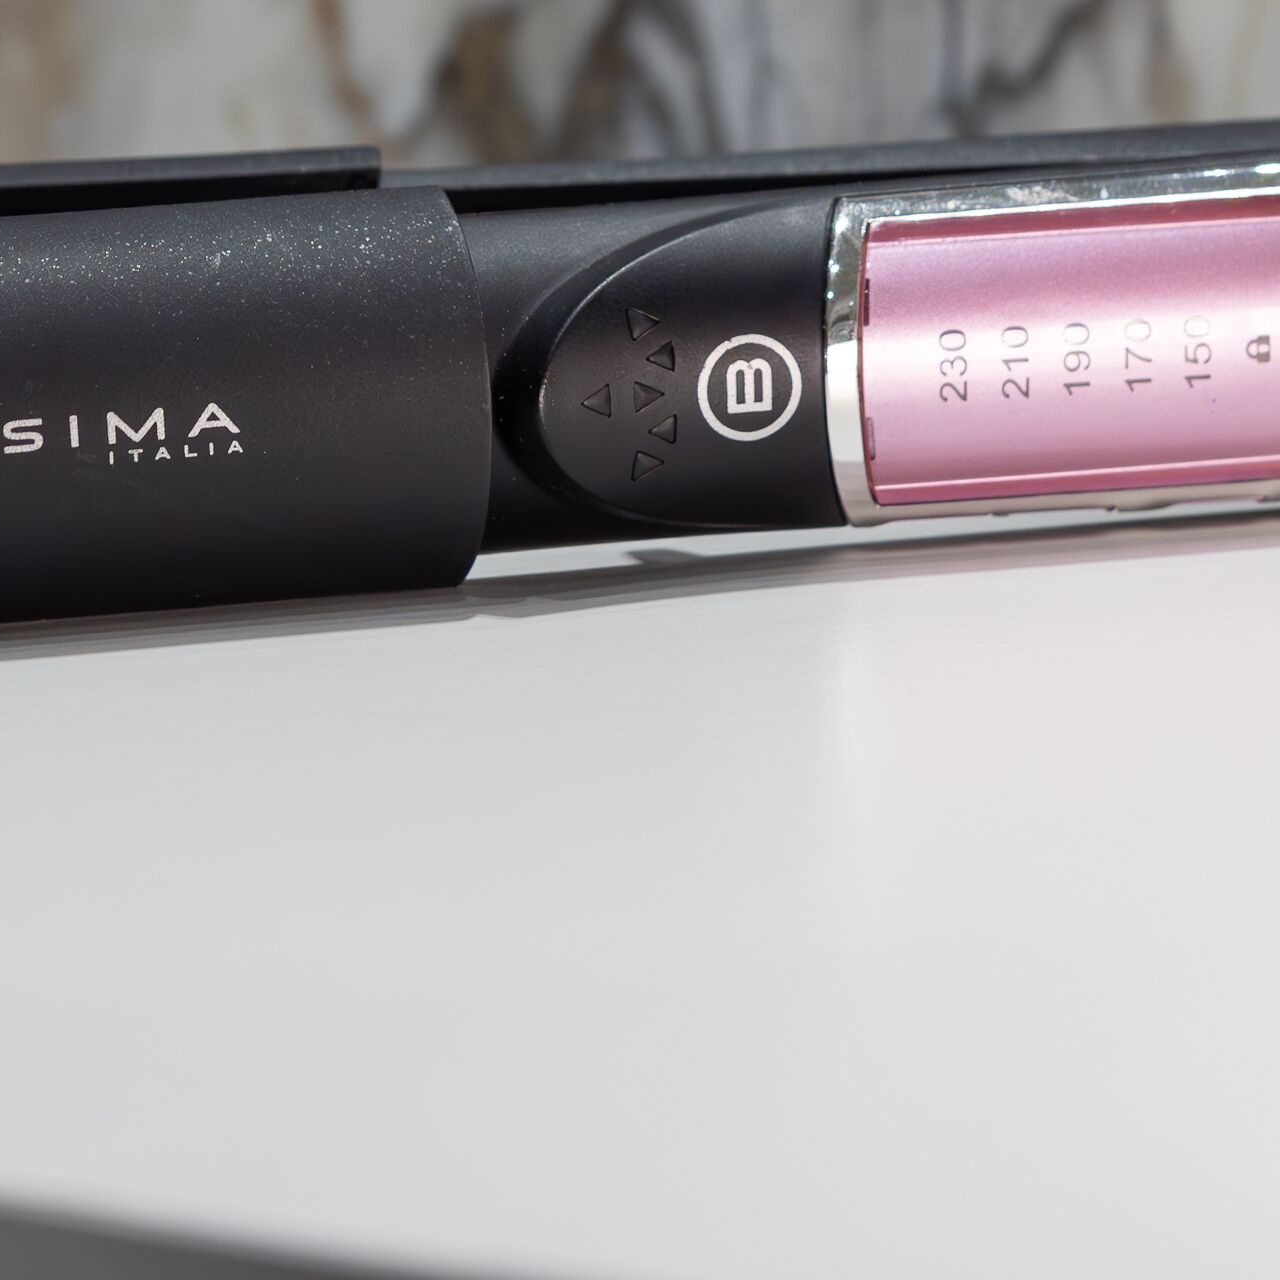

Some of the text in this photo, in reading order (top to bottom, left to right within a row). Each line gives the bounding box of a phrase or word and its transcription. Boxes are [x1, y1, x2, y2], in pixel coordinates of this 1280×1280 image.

[938, 328, 969, 403] 230
[1000, 325, 1031, 400] 210
[1062, 322, 1092, 397] 190
[1123, 318, 1154, 394] 170
[1184, 314, 1214, 389] 150
[108, 440, 244, 465] ITALIA
